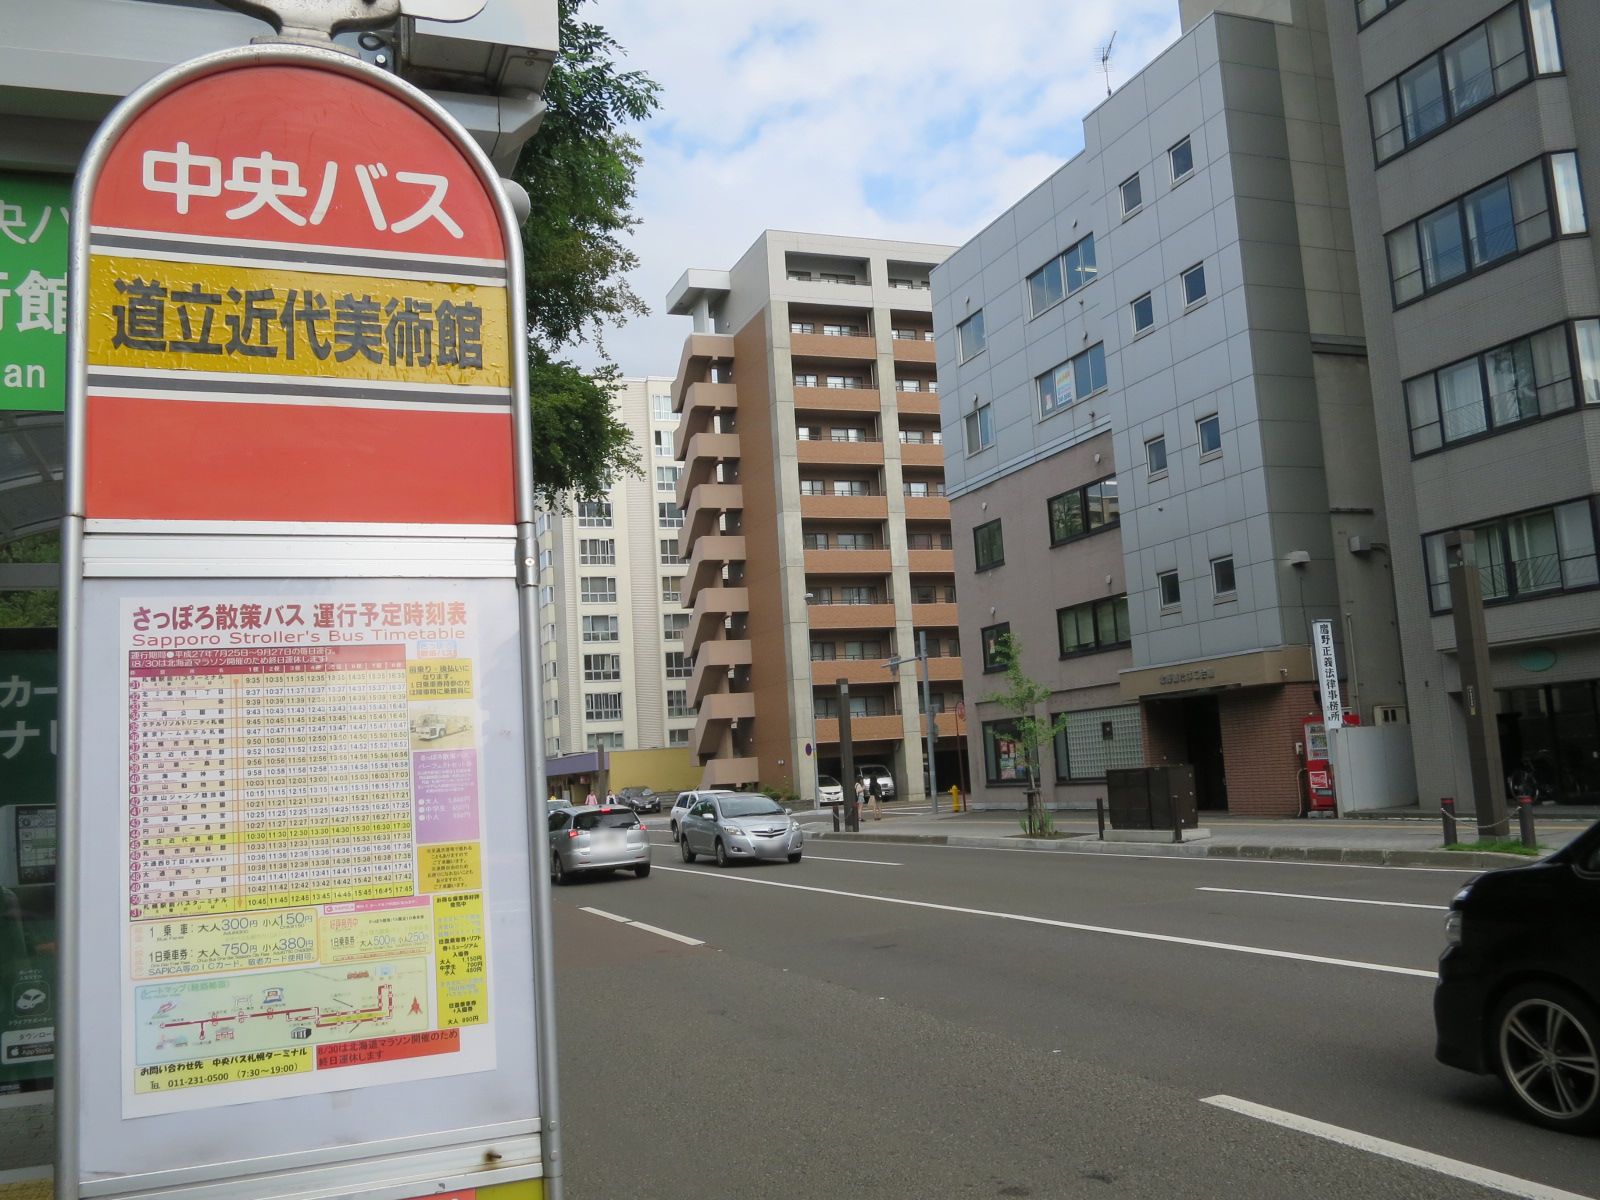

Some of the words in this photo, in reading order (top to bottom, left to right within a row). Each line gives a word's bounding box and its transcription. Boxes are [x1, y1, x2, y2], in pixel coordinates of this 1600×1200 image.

[142, 141, 464, 239] 中央バス
[110, 276, 484, 370] 道立近代美術館
[3, 363, 46, 388] an
[132, 603, 305, 631] さっぽろ散策バス
[313, 601, 467, 629] 運行予定時刻表
[132, 633, 221, 649] Sapporo
[229, 631, 321, 645] Stroller's
[329, 630, 364, 642] Bus
[372, 628, 466, 641] Timetable
[212, 1048, 308, 1067] 中央バス札幌ターミナル
[168, 1073, 229, 1088] 011-231-0500
